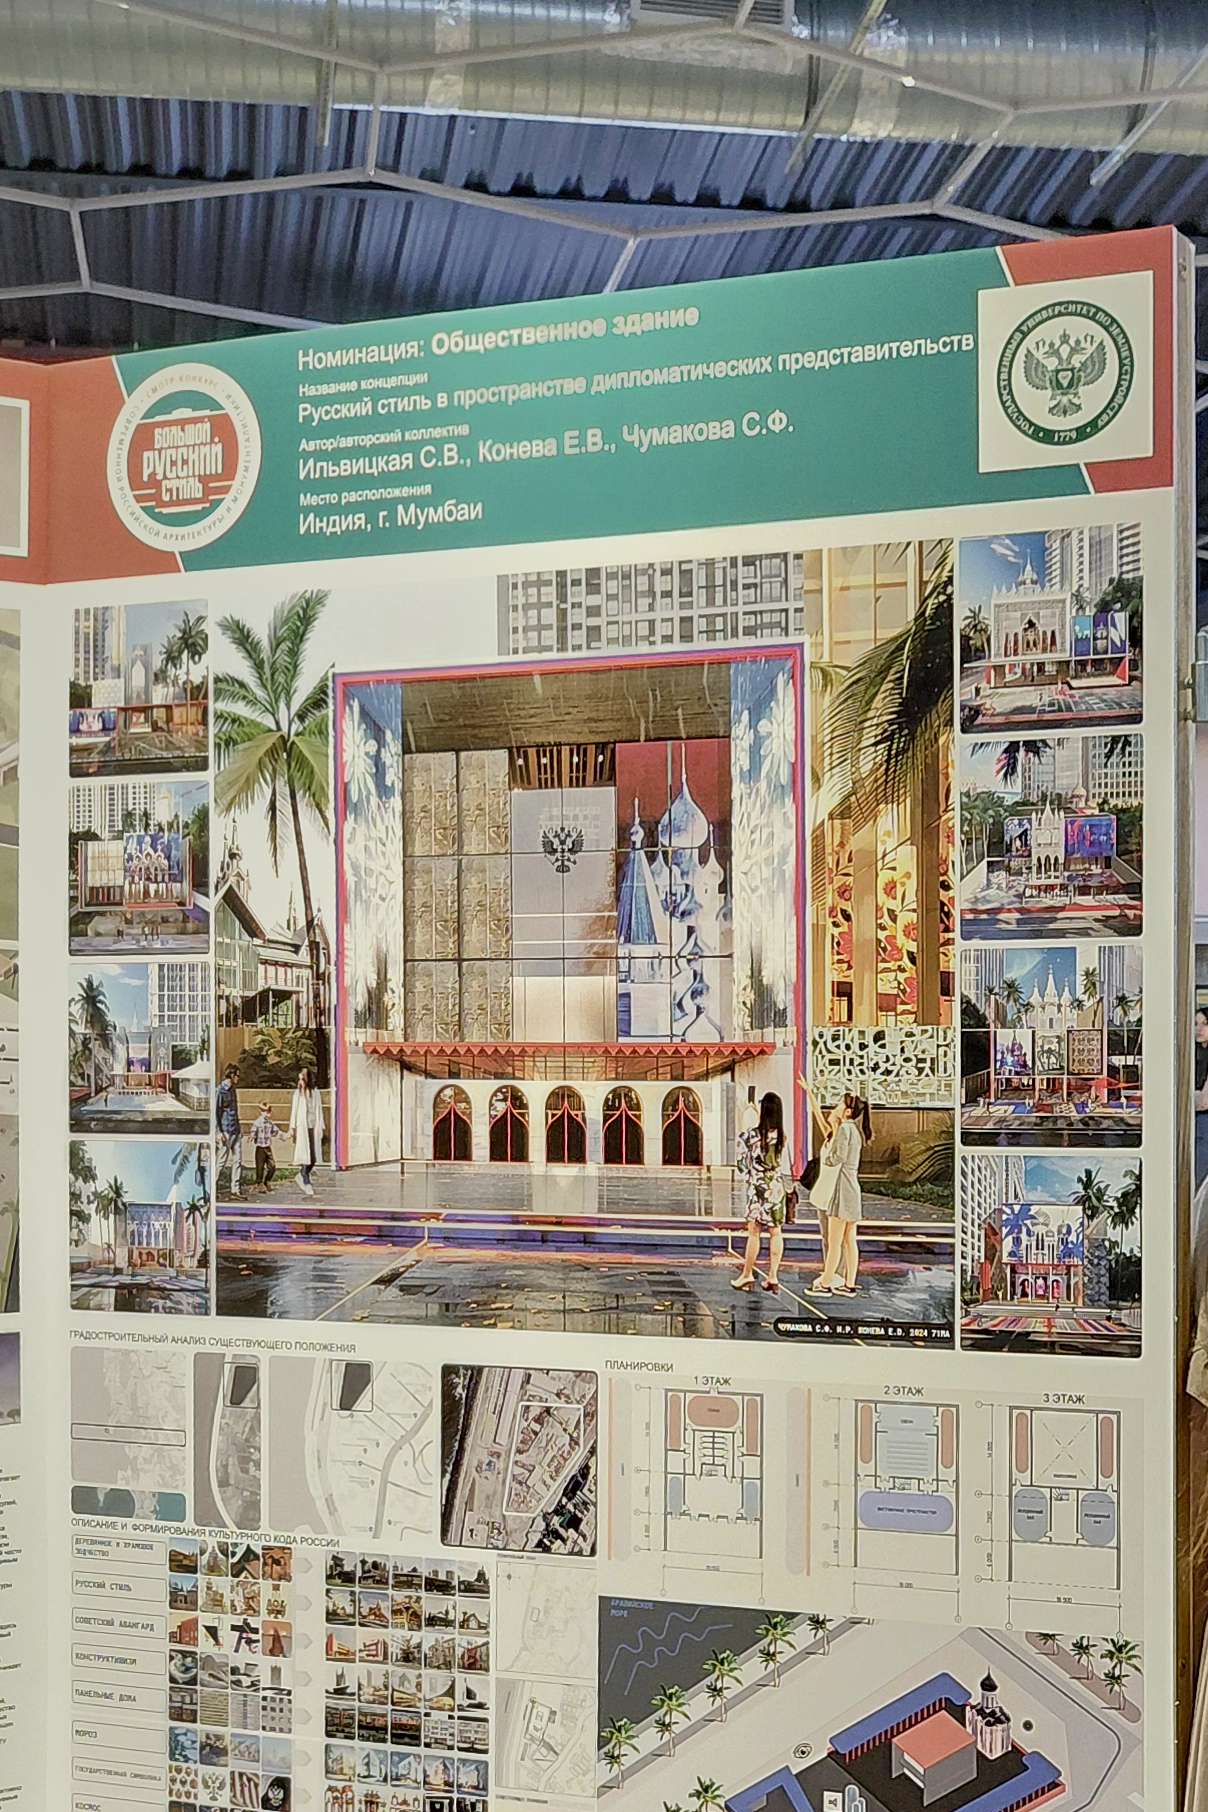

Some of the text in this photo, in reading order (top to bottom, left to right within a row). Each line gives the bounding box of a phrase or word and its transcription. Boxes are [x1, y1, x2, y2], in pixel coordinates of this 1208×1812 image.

[298, 306, 700, 371] Номинация: Общественное здание
[298, 333, 975, 426] Русский стиль в пространстве дипломатических представительств
[299, 372, 428, 398] Название концепции
[154, 417, 211, 449] БОЛЬШОЙ
[299, 423, 470, 452] Автор/авторский коллектив
[299, 409, 794, 480] Ильвицкая С.В., Конева Е.В., Чумакова С.Ф.
[1053, 430, 1077, 442] 1779
[142, 436, 223, 482] РУССКИЙ
[161, 476, 203, 502] СТИЛЬ
[300, 484, 432, 507] Место расположения
[299, 499, 483, 536] Индия, г. Мумбаи
[69, 1330, 356, 1354] ГРАДОСТРОИТЕЛЬНЫЙ АНАЛИЗ СУЩЕСТВУЮЩЕГО ПОЛОЖЕНИЯ
[605, 1359, 674, 1373] ПЛАНИРОВКИ
[694, 1376, 731, 1387] 1 ЭТАЖ
[884, 1385, 924, 1397] 2 ЭТАЖ
[1043, 1394, 1085, 1405] 3 ЭТАЖ
[71, 1518, 340, 1548] ОПИСАНИЕ И ФОРМИРОВАНИЯ КУЛЬТУРНОГО КОДА РОССИИ
